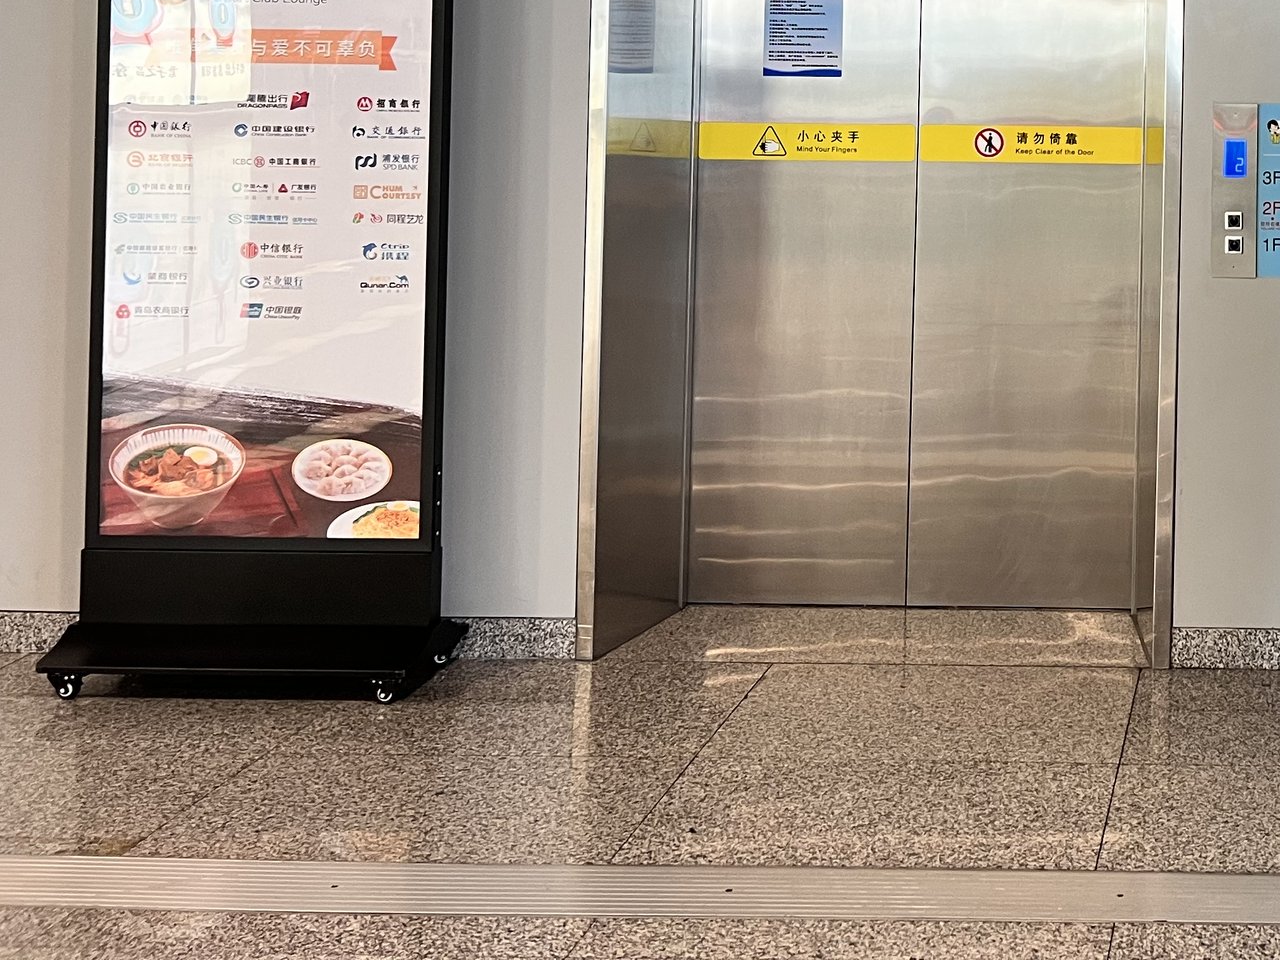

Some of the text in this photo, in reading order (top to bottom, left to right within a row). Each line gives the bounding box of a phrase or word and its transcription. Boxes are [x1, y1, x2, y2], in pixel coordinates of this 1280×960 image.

[251, 125, 315, 134] 中国建设银行
[796, 129, 860, 143] 小心夹手
[1016, 131, 1078, 145] 请勿倚靠
[797, 145, 858, 154] Mind Your Fingers
[1015, 148, 1033, 156] Keep
[1235, 157, 1244, 173] 2
[260, 242, 304, 254] 中信银行
[380, 242, 410, 250] Ctrip
[360, 281, 409, 289] Qunar.Com
